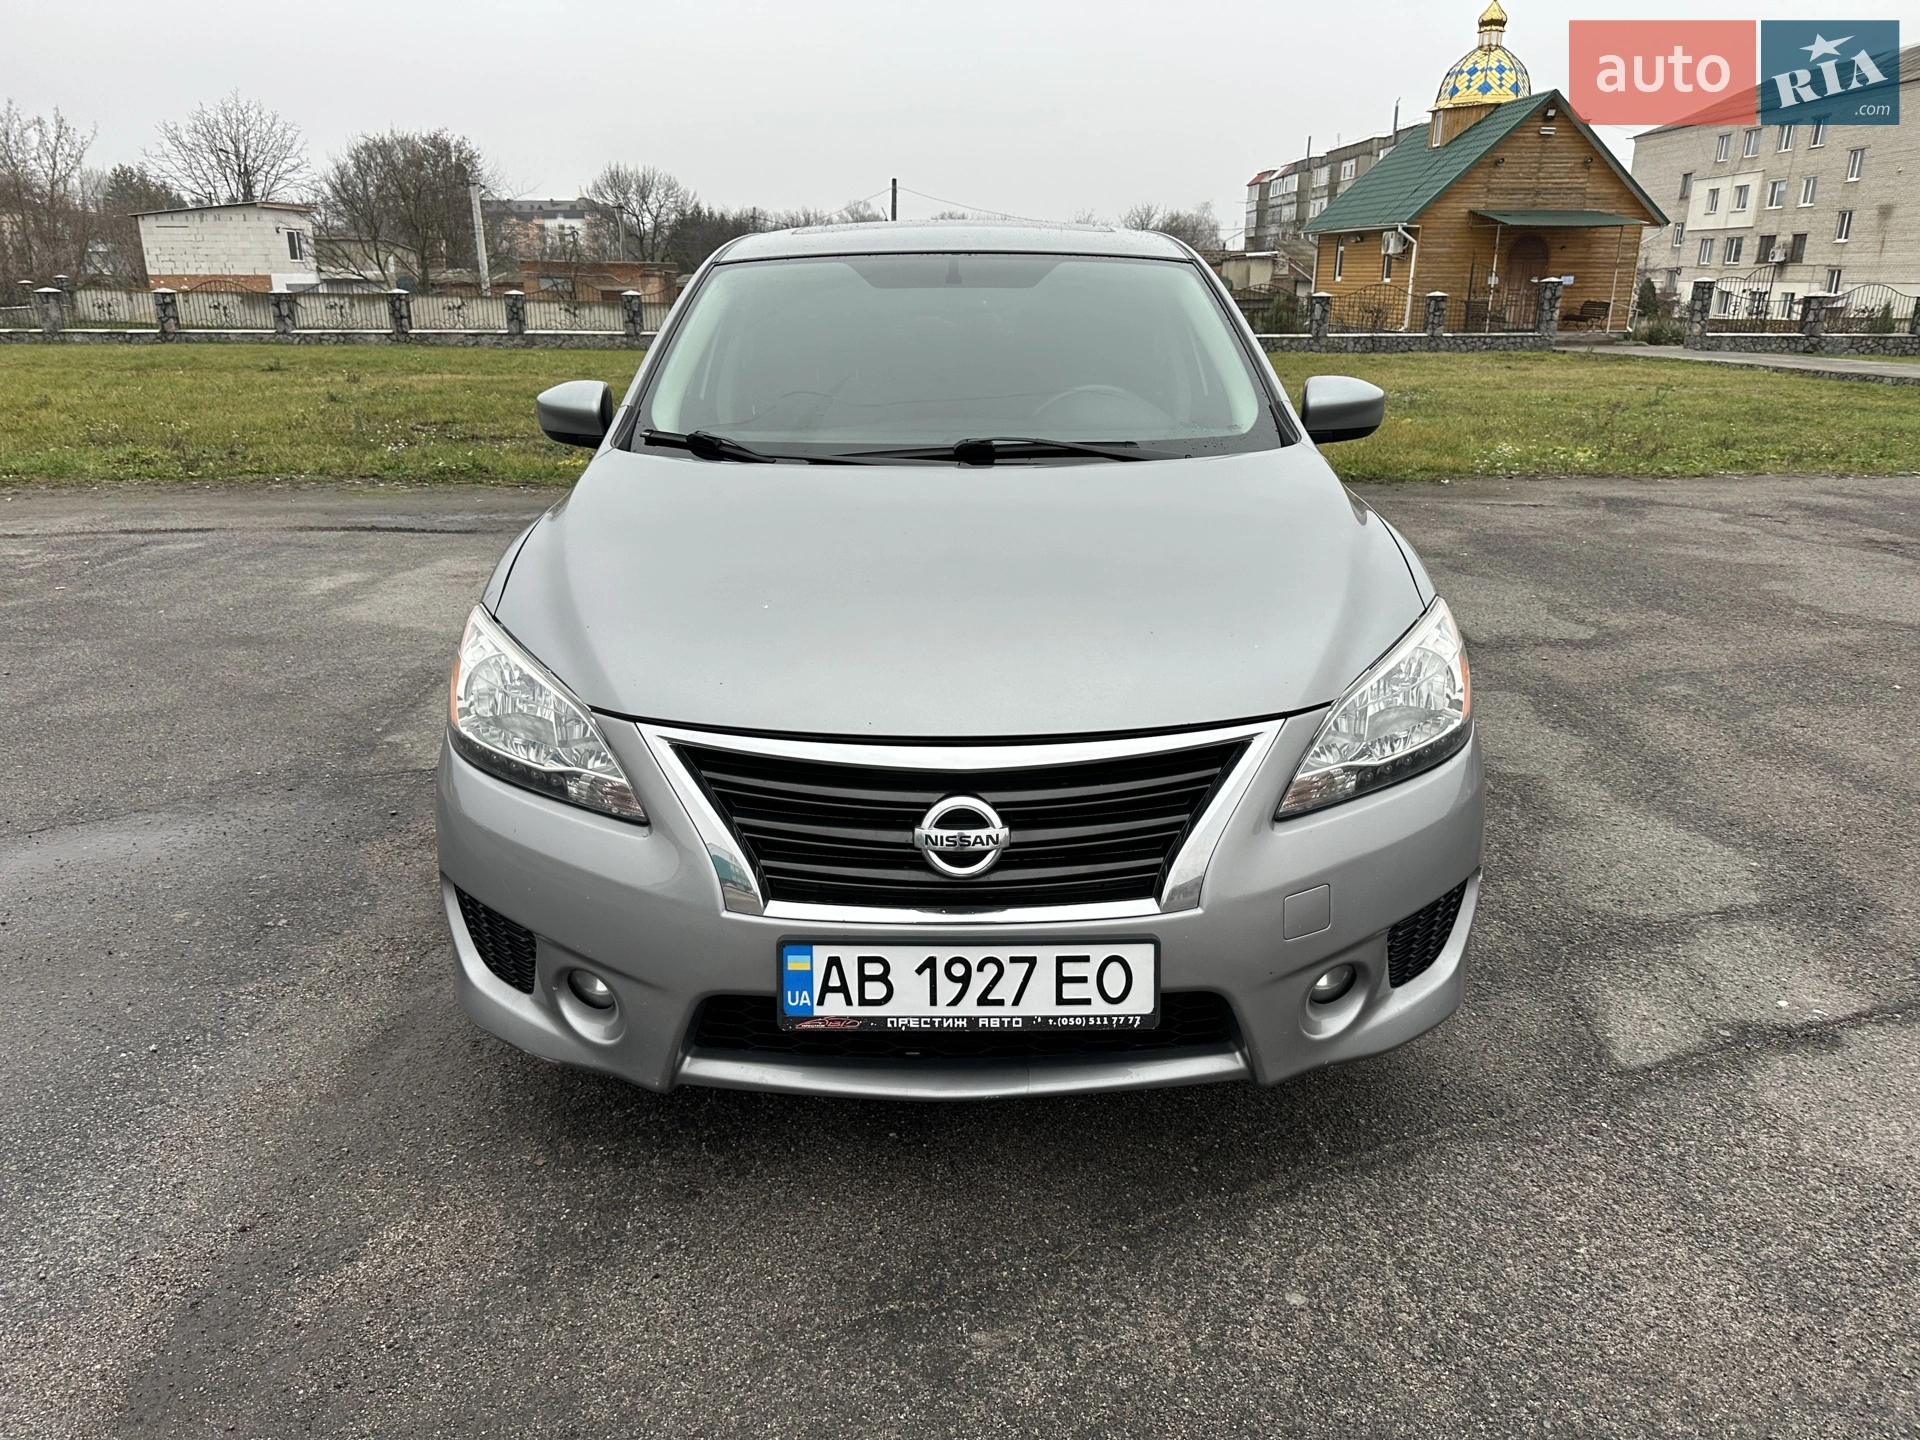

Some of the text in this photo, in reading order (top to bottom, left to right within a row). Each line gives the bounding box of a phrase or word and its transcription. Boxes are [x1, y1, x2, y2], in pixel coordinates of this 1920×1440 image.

[925, 833, 999, 847] NISSAN
[816, 955, 1133, 1006] AB 1927 EO
[787, 990, 811, 1006] UA
[887, 1017, 967, 1028] ПРЕСТИЖ
[978, 1017, 1022, 1028] АВТО
[1088, 1016, 1109, 1025] 511
